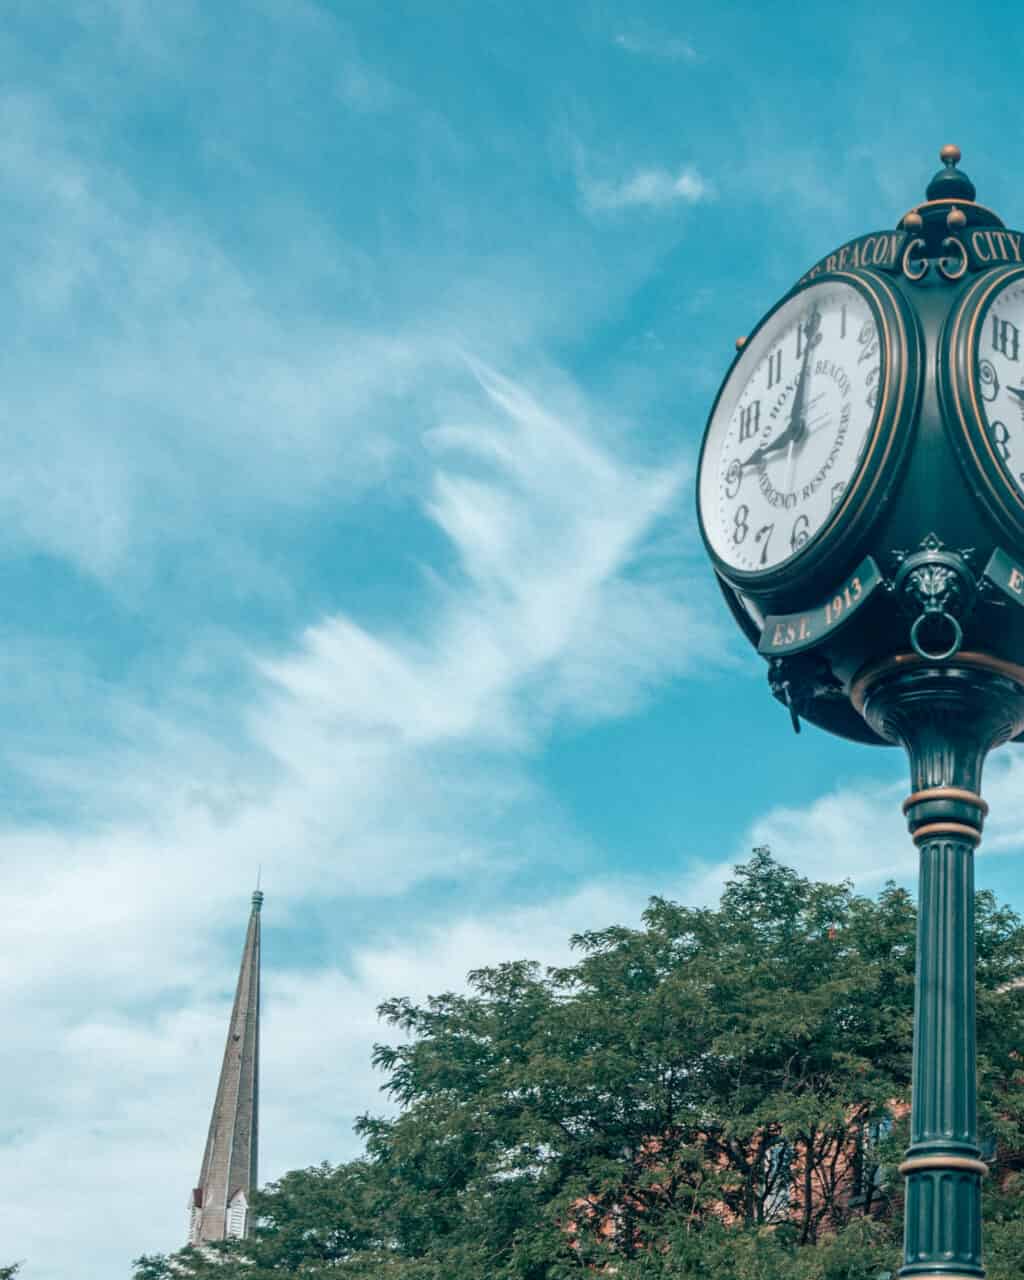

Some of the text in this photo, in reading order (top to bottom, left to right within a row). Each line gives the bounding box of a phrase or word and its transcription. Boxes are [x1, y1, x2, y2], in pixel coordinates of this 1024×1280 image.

[826, 234, 902, 272] BEACON
[972, 231, 1022, 262] CITY
[796, 311, 823, 360] 12
[840, 304, 847, 339] 1
[992, 314, 1019, 362] 10
[767, 349, 783, 390] 11
[815, 359, 849, 398] BEACON
[979, 359, 1000, 402] 9
[739, 400, 760, 443] 10
[759, 402, 850, 509] MERGENCY RESPONDERS
[725, 458, 743, 499] 9
[733, 504, 749, 544] 8
[755, 523, 775, 564] 7
[790, 515, 809, 552] 6
[772, 577, 862, 646] EST. 1913
